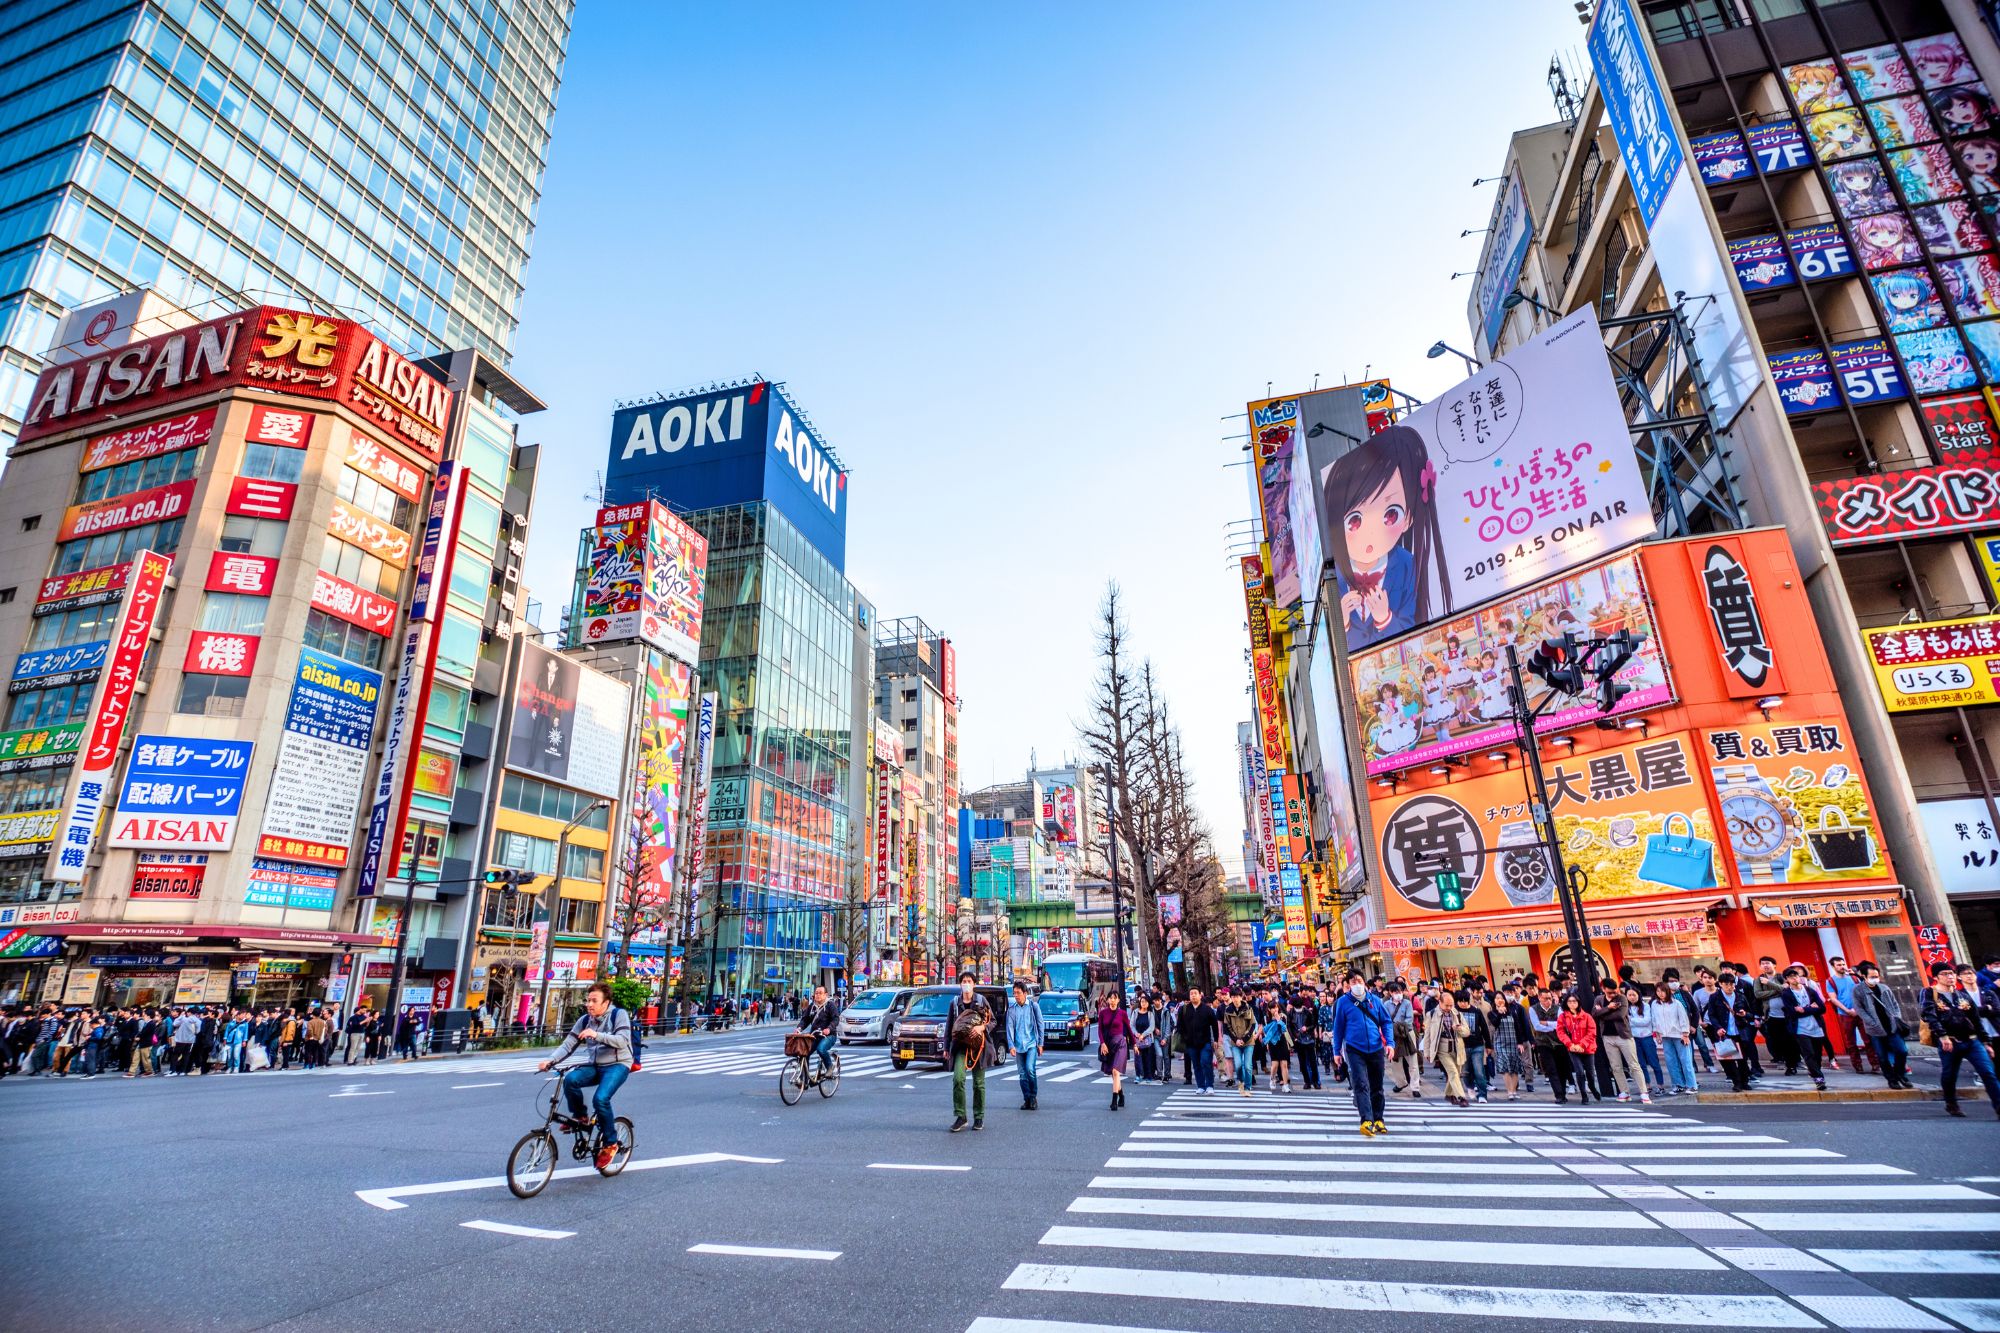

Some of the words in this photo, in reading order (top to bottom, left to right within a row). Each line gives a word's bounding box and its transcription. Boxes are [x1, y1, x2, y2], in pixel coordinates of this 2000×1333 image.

[1691, 134, 1740, 149] トレーディング
[1695, 143, 1744, 160] アメニティ
[1758, 143, 1807, 171] 7F
[1728, 236, 1779, 251] トレーディング
[1731, 246, 1783, 262] アメニティ
[1799, 246, 1850, 278] 6F
[262, 314, 338, 367] 光
[1550, 319, 1586, 343] KADOKAWA
[26, 317, 243, 425] AISAN
[247, 361, 337, 388] ネットワーク
[1769, 352, 1823, 368] トレーディング
[1772, 363, 1827, 380] アメニティ
[357, 338, 450, 430] AISAN
[1844, 365, 1899, 399] 5F
[1485, 377, 1508, 420] 友達に
[259, 411, 303, 443] 愛
[621, 395, 745, 460] AOKI
[1468, 390, 1491, 444] なりたい
[1939, 433, 1992, 450] Stars
[774, 410, 837, 514] AOKI
[1463, 442, 1593, 511] ひとりぼっちの
[73, 493, 182, 534] aisan.co.jp
[240, 483, 284, 514] 三
[604, 506, 644, 523] 免税店
[1836, 468, 2000, 532] メイド
[331, 505, 409, 559] ネットワーク
[1464, 536, 1545, 582] 2019.4.5
[1550, 518, 1584, 542] ON
[1589, 500, 1628, 528] AIR
[42, 580, 64, 598] 3F
[221, 557, 266, 591] 電
[313, 575, 394, 627] 配線パーツ
[17, 658, 39, 674] 2F
[198, 636, 247, 672] 機
[302, 664, 377, 702] aisan.co.jp
[1619, 664, 1645, 681] cafe
[1900, 668, 1965, 688] りらくる
[1896, 690, 1986, 707] 秋葉原中央通り店
[700, 697, 713, 741] AKKY
[137, 744, 245, 768] 各種ケーブル
[1546, 739, 1693, 812] 大黒屋
[126, 782, 236, 806] 配線パーツ
[60, 781, 102, 867] 愛三電機
[116, 818, 228, 842] AISAN
[1259, 792, 1271, 841] Tax-free
[1266, 843, 1276, 873] Shop
[1955, 821, 1993, 841] 喫茶
[362, 807, 385, 887] AISAN
[1645, 916, 1705, 933] 無料査定
[1920, 928, 1940, 940] 4F
